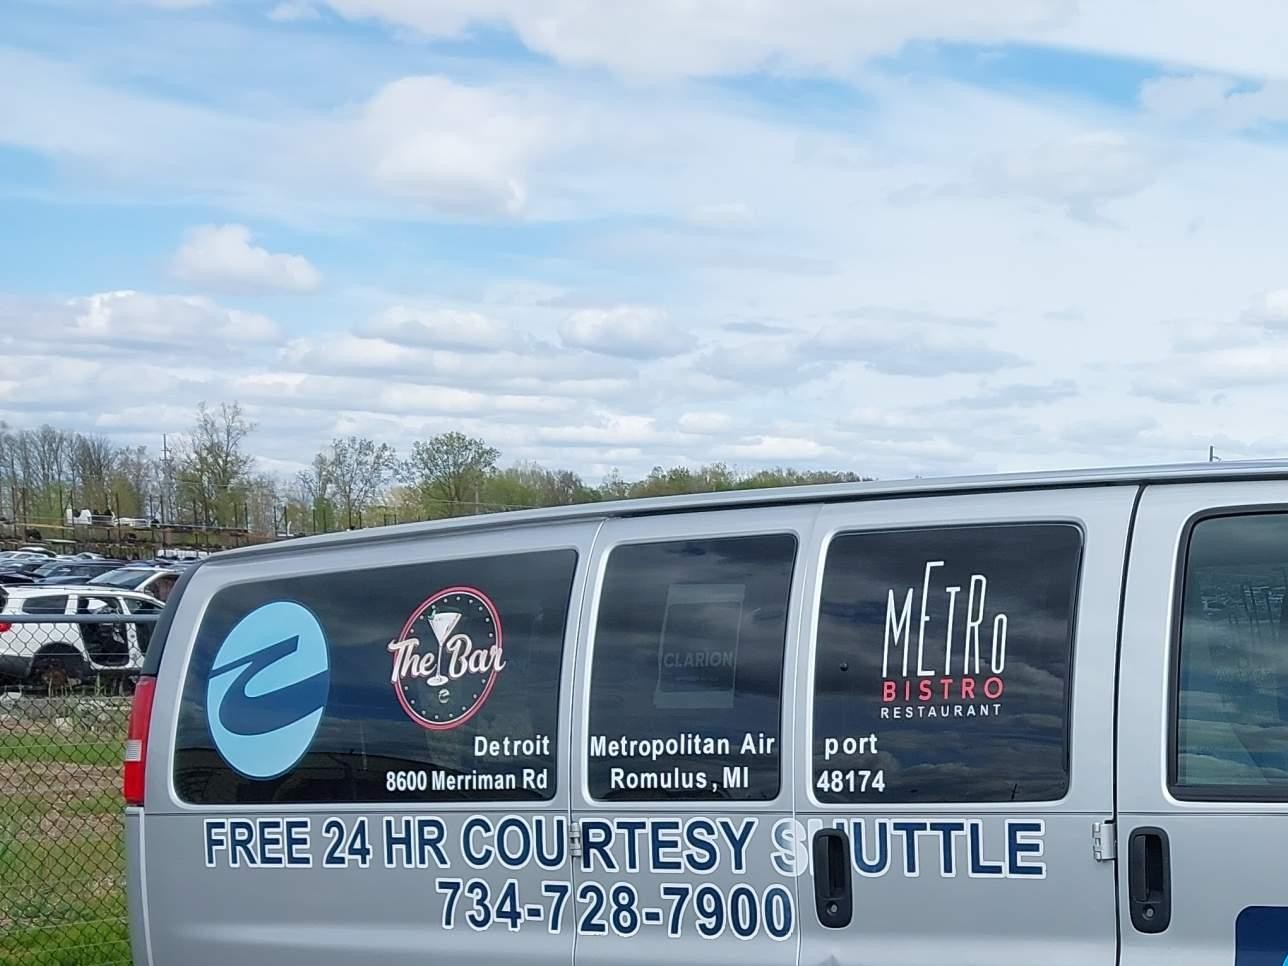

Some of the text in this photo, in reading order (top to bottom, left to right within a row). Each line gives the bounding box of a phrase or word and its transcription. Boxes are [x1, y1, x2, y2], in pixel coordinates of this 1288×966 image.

[388, 633, 506, 684] The Bar
[663, 650, 733, 669] CLARION
[882, 676, 1004, 702] BISTRO
[880, 703, 1001, 719] RESTAURANT
[474, 735, 550, 756] Detroit
[590, 733, 730, 761] Metropolitan
[386, 770, 427, 792] 8600
[431, 769, 516, 791] Merriman
[522, 768, 548, 789] Rd
[723, 766, 749, 788] MI
[816, 770, 886, 792] 48174
[203, 817, 312, 868] FREE
[322, 816, 372, 868] 24
[383, 815, 451, 869] HR
[770, 817, 1047, 879] SUTTLE
[435, 878, 794, 940] 734-728-7900
